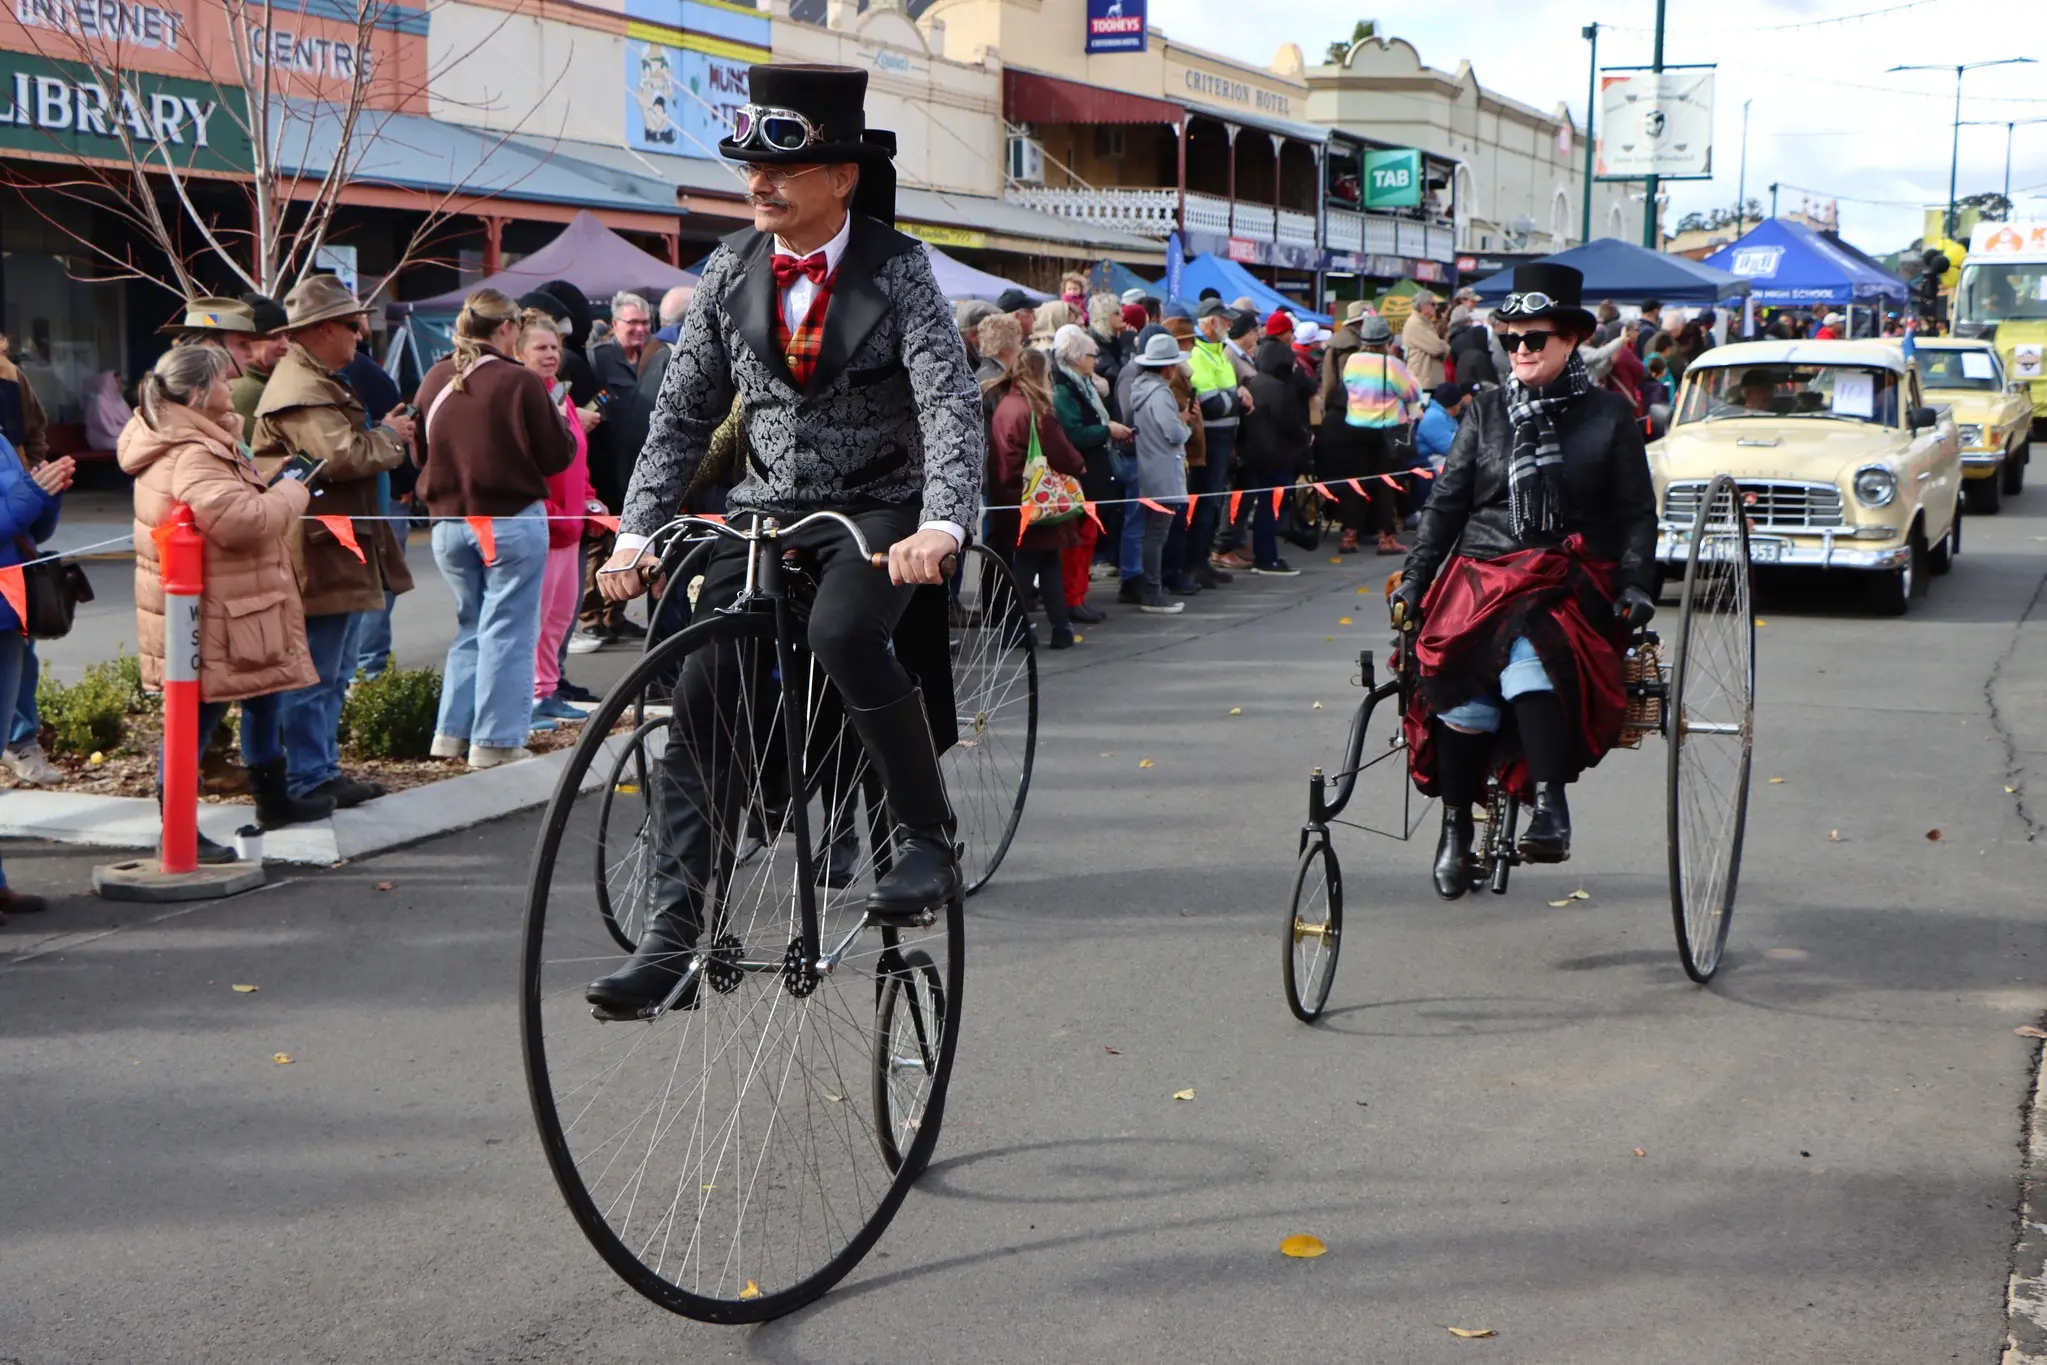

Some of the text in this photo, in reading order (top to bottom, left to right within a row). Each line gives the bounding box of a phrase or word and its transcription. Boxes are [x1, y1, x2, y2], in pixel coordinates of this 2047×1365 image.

[1091, 17, 1140, 33] TOOHEYS
[1185, 69, 1290, 115] CRITERION HOTEL
[1372, 169, 1410, 188] TAB
[1764, 289, 1791, 299] HIGH
[1791, 288, 1835, 300] SCHOOL
